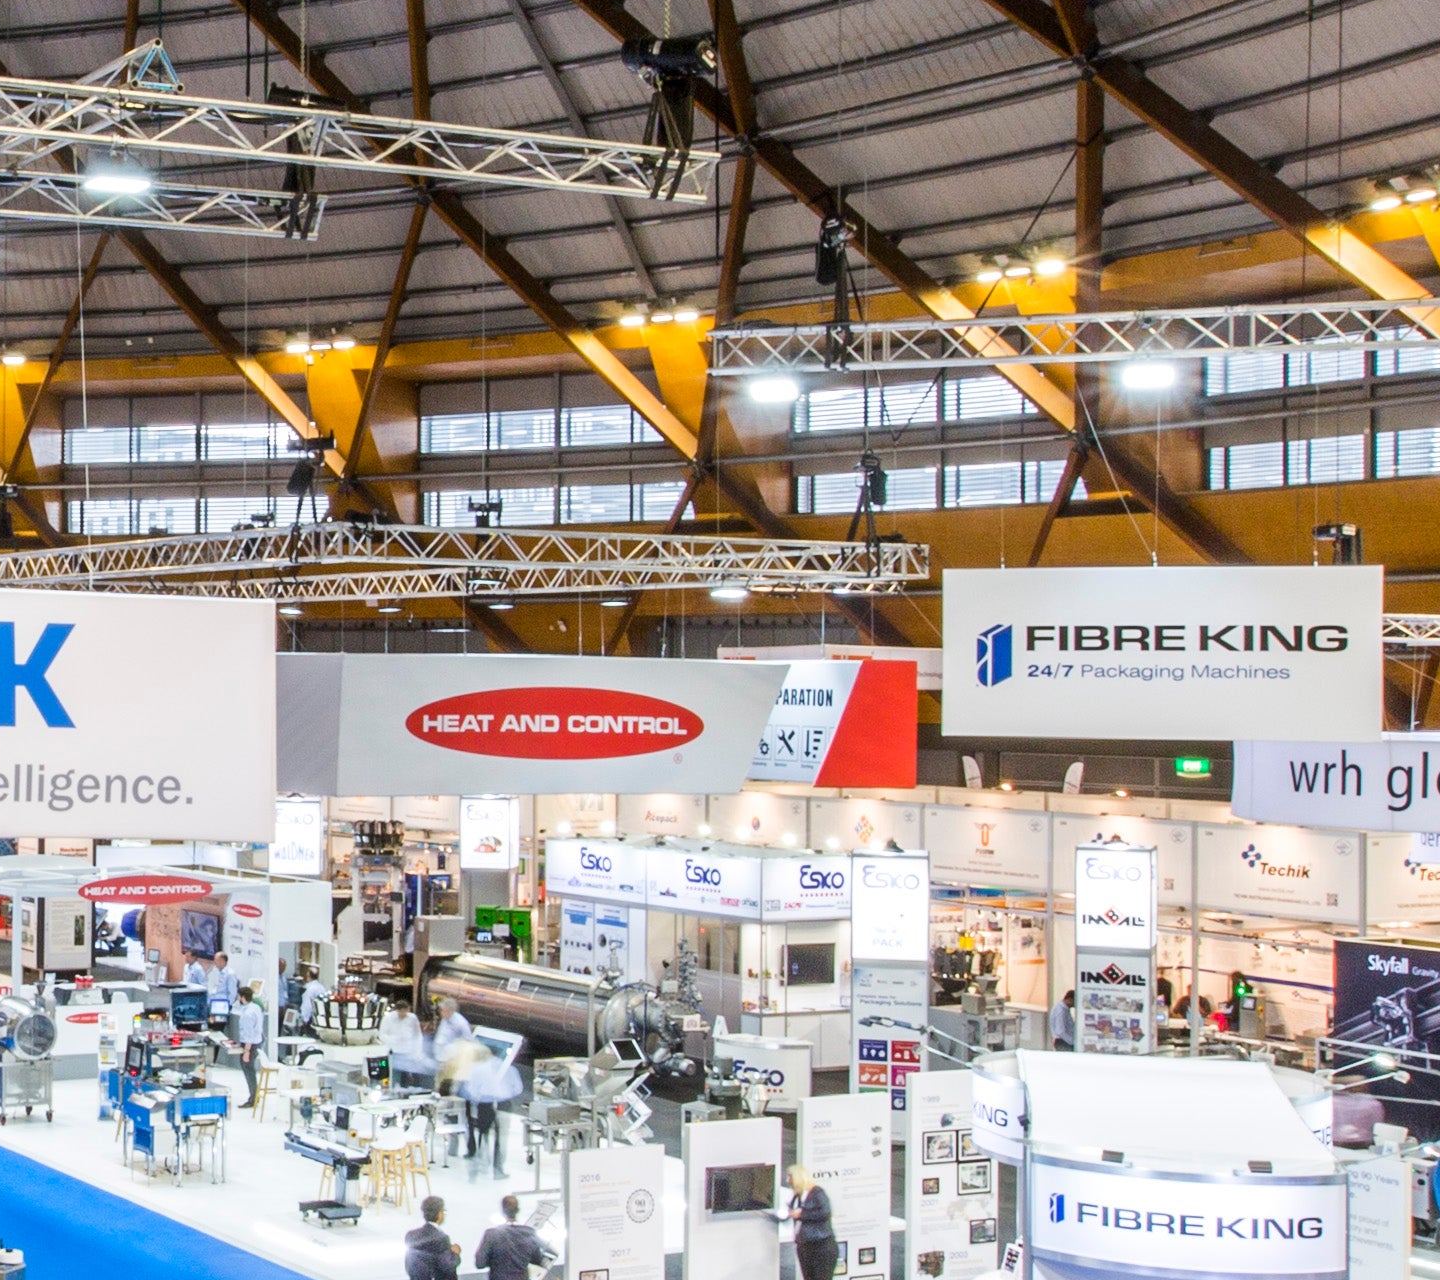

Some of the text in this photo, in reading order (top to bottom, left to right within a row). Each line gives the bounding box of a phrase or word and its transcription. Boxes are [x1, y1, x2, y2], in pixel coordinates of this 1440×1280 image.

[1026, 625, 1348, 652] FIBRE KING
[1027, 663, 1290, 683] 24/7 Packaging Machines
[422, 714, 687, 736] HEAT AND CONTROL
[1289, 750, 1362, 797] wrh
[1260, 862, 1311, 879] Techik
[84, 884, 206, 897] HEAT AND CONTROL
[1368, 954, 1409, 976] Skyfall
[1077, 1201, 1324, 1240] FIBRE KING
